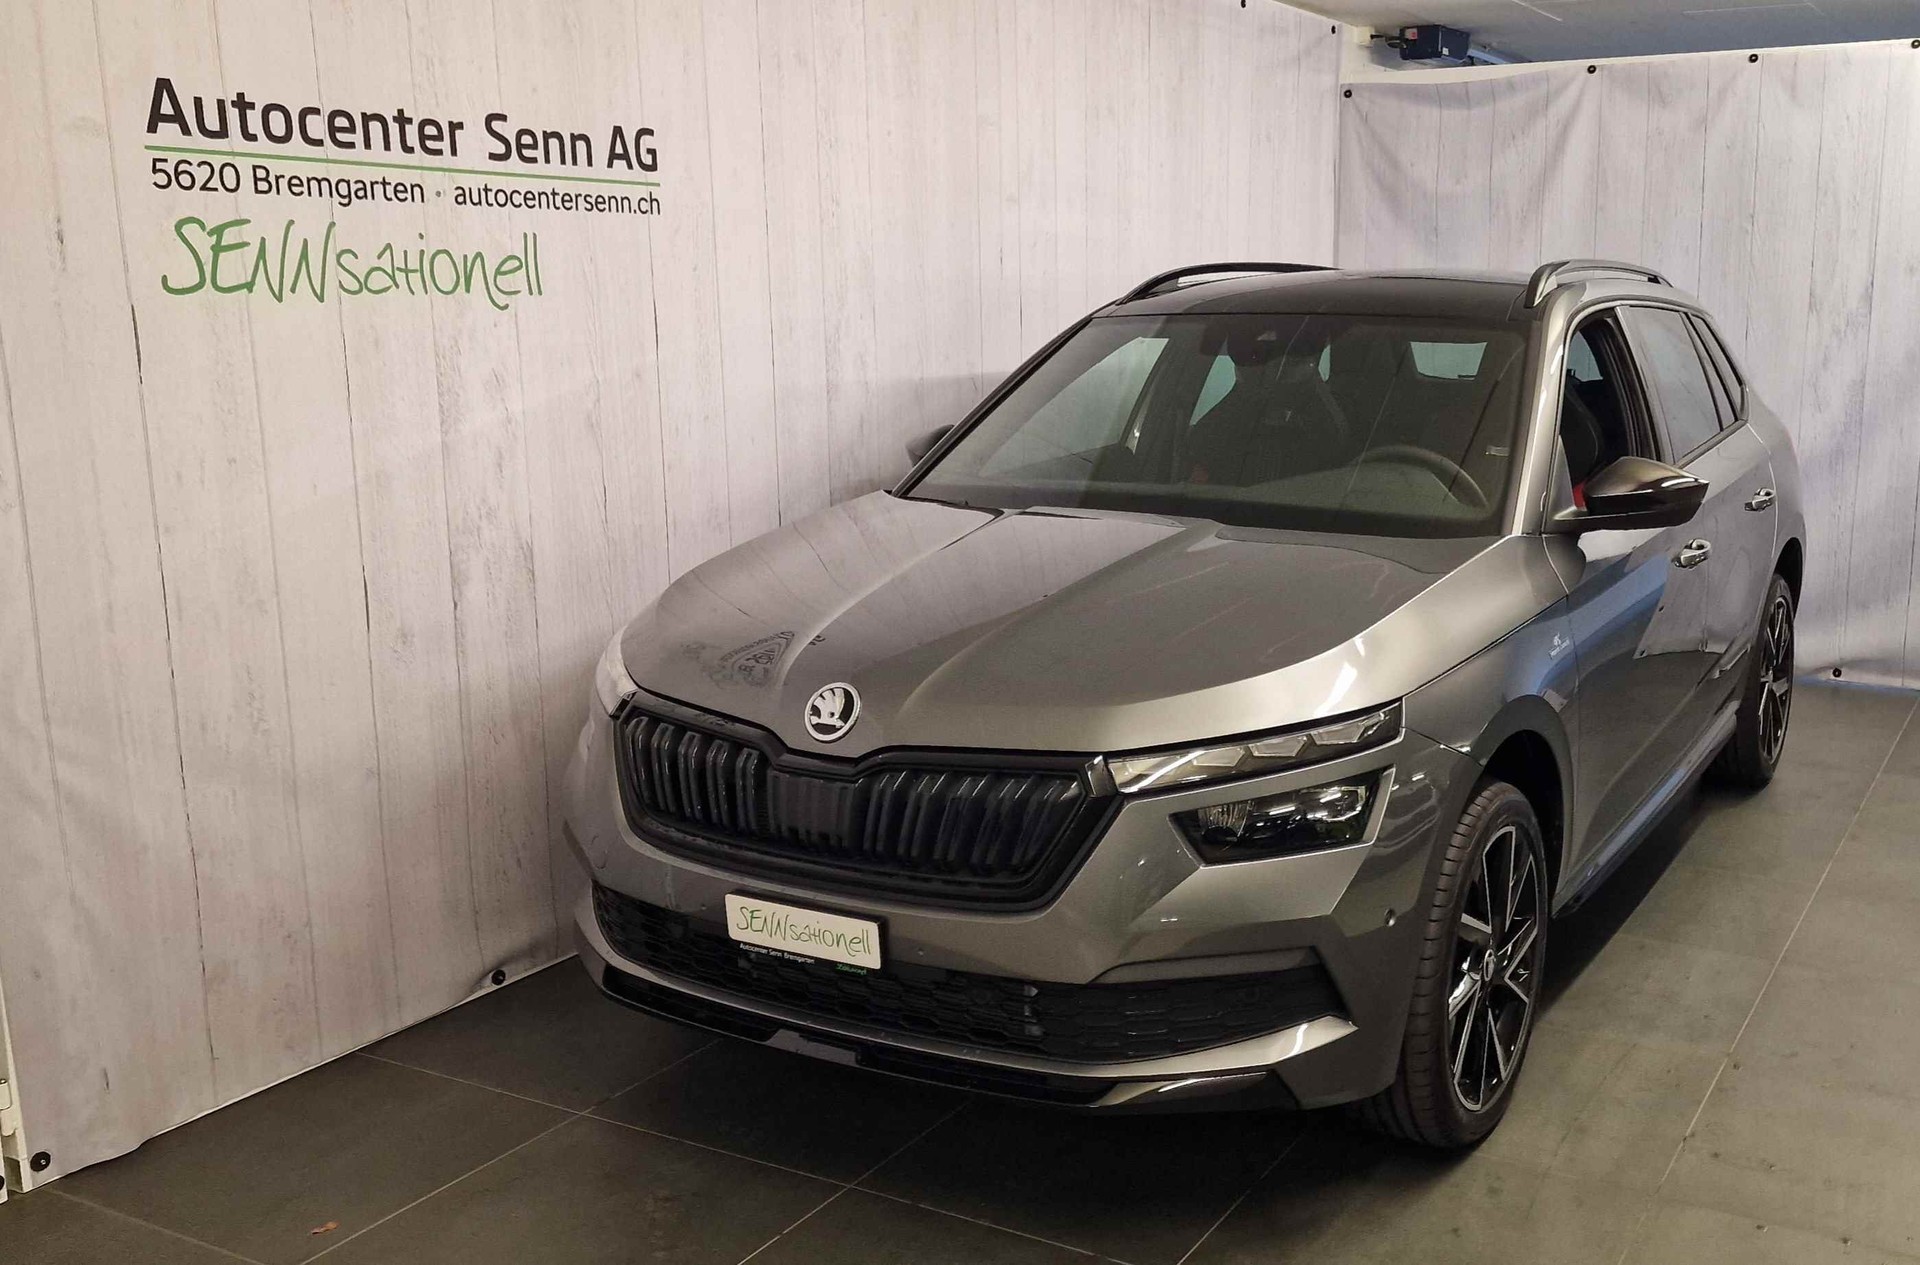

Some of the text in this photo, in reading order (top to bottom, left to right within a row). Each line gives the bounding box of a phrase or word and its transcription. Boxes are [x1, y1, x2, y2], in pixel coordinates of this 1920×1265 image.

[145, 77, 658, 172] Autocenter Senn AG
[151, 158, 661, 215] 5620 Bremgarten autocentersenn.ch
[161, 217, 543, 310] SENNsationell
[736, 906, 871, 957] SENNsationell
